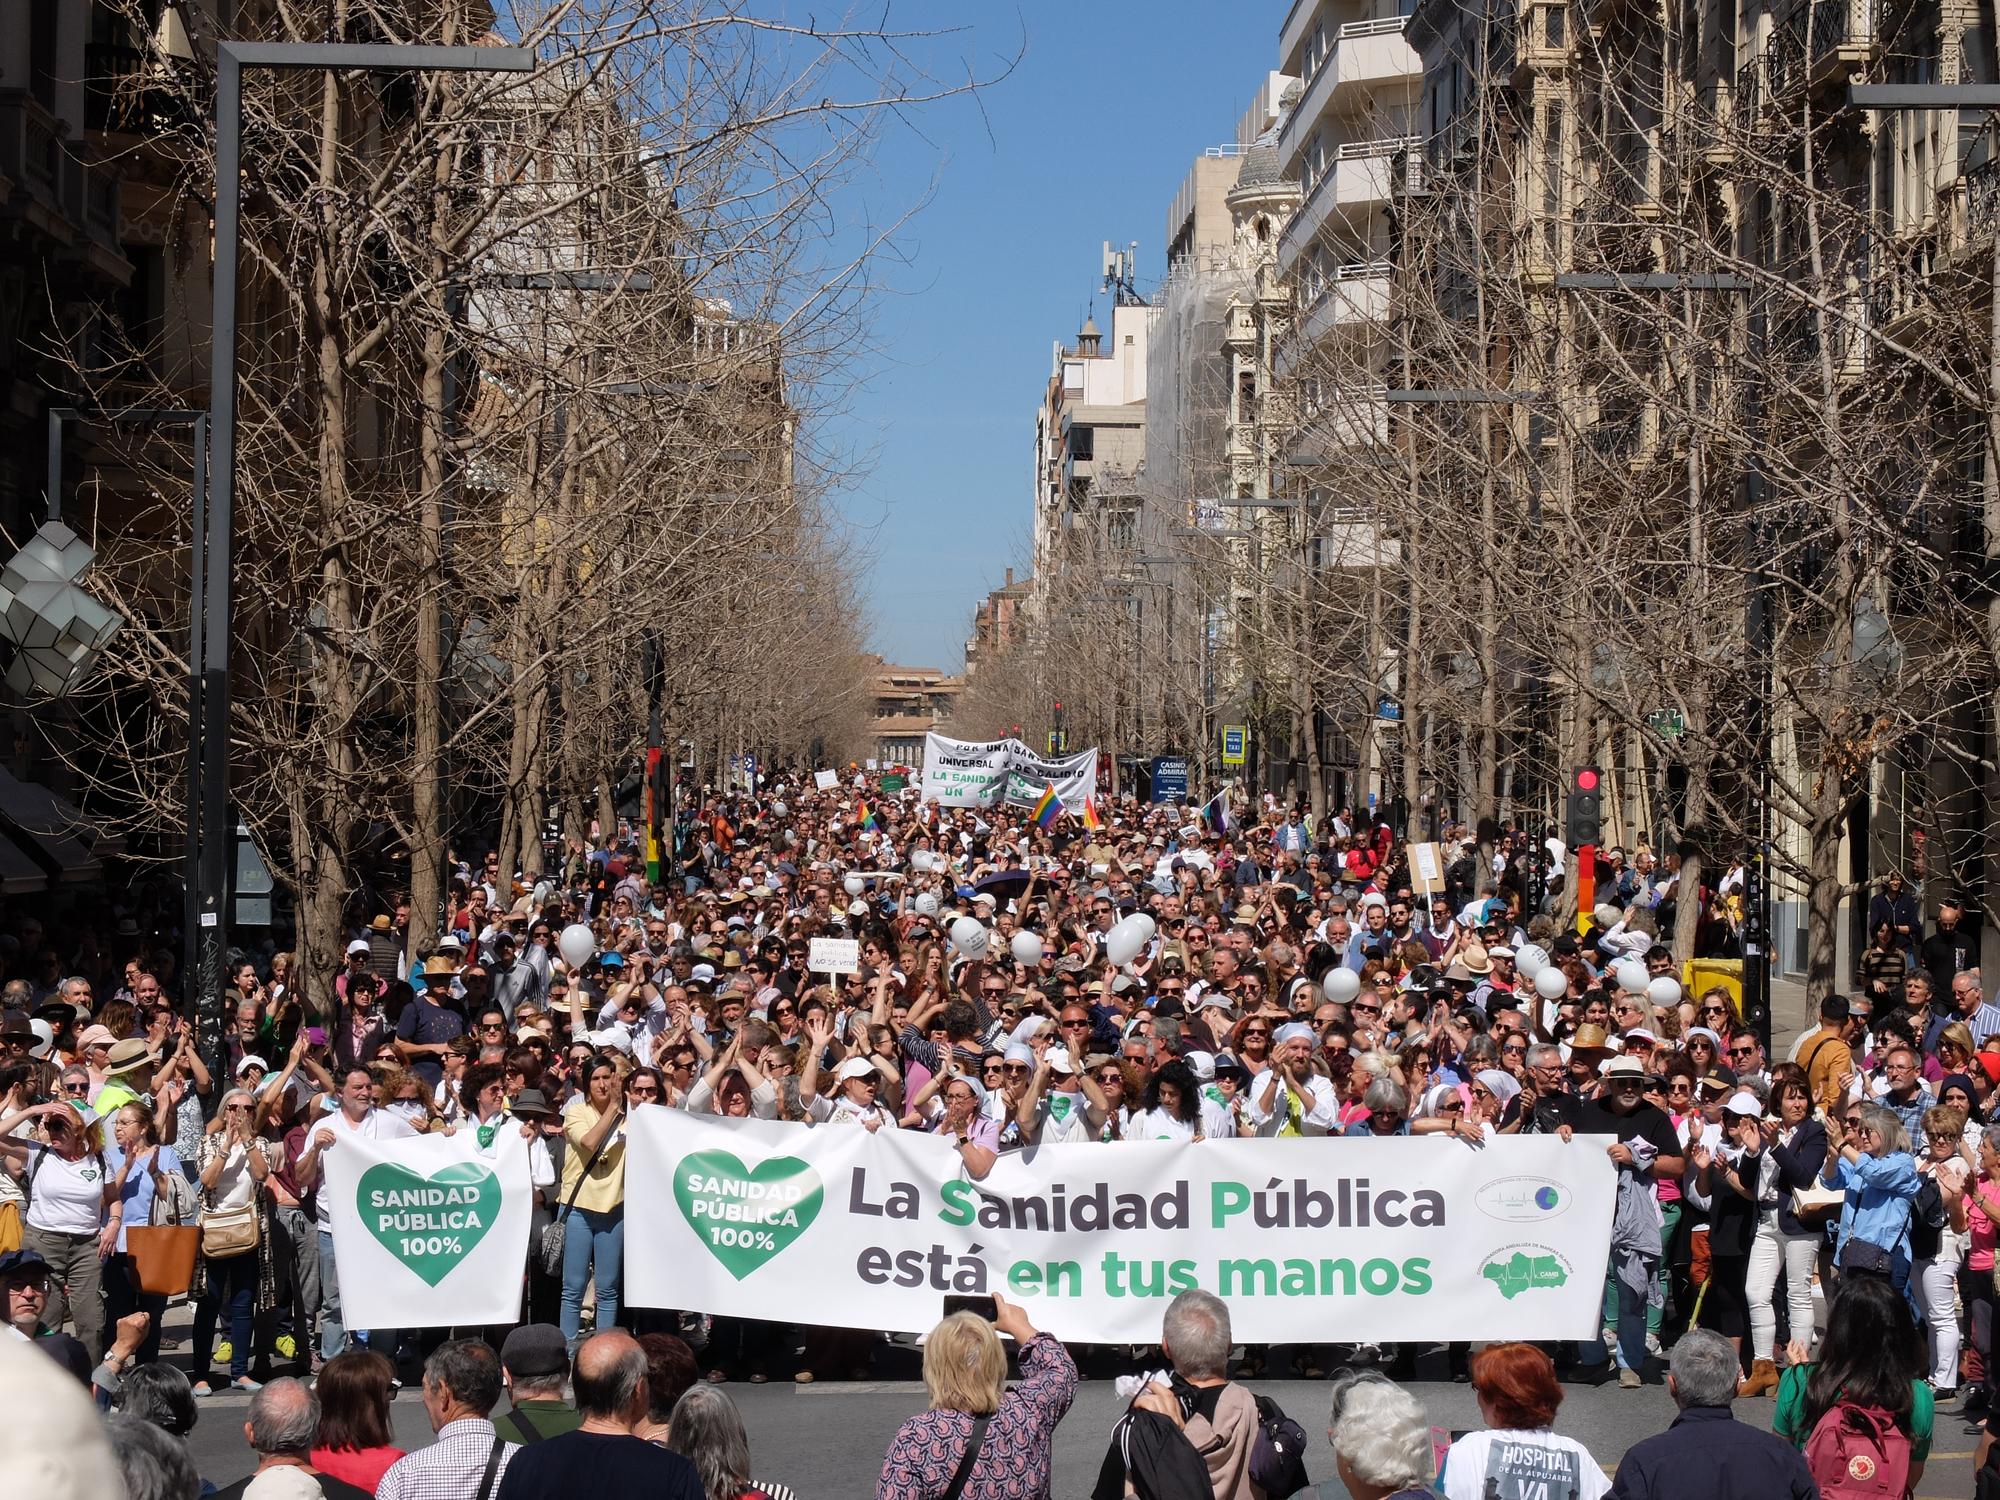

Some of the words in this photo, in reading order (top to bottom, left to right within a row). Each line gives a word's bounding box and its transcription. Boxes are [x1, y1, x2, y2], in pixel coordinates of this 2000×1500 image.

[986, 744, 1009, 752] UNA
[938, 756, 994, 769] UNIVERSAL
[1003, 761, 1010, 769] Y
[1015, 763, 1031, 774] DE
[1160, 761, 1186, 769] CASINO
[932, 771, 947, 781] LA
[952, 773, 1001, 784] SANIDAD
[944, 787, 963, 797] UN
[815, 958, 827, 966] NO
[371, 1186, 480, 1208] SANIDAD
[687, 1173, 802, 1201] SANIDAD
[849, 1167, 920, 1220] La
[939, 1179, 1189, 1233] Sanidad
[1211, 1176, 1446, 1229] Pública
[379, 1208, 482, 1232] PÚBLICA
[691, 1198, 799, 1229] PÚBLICA
[400, 1236, 462, 1257] 100%
[710, 1226, 775, 1252] 100%
[856, 1243, 987, 1294] está
[1006, 1257, 1082, 1298] en
[1101, 1251, 1198, 1298] tus
[1218, 1256, 1432, 1297] manos
[1502, 1445, 1572, 1472] HOSPITAL
[1526, 1470, 1573, 1483] ALPUJARRA
[1517, 1479, 1548, 1500] YA
